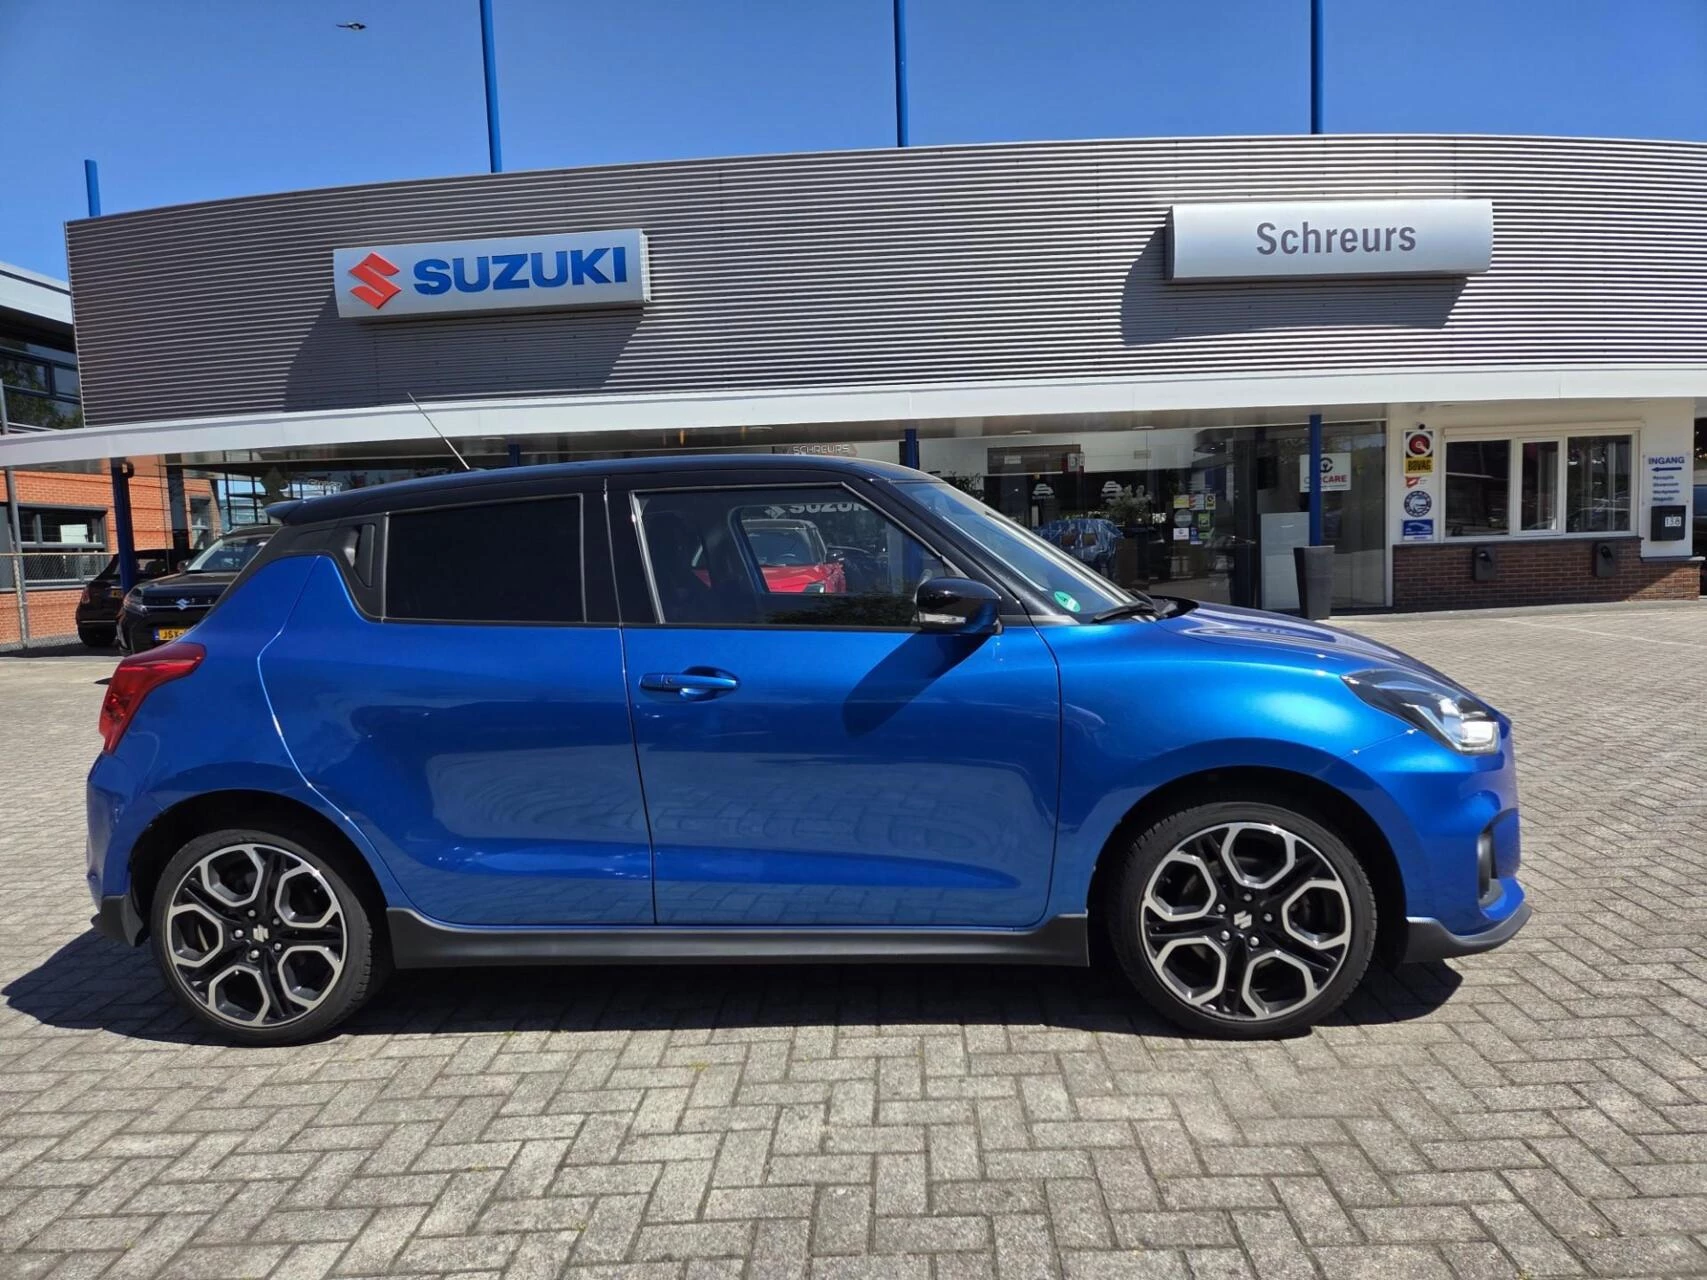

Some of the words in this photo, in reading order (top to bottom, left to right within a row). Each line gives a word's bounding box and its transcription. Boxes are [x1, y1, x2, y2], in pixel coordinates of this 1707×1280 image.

[1256, 221, 1416, 255] Schreurs
[413, 246, 628, 295] SUZUKI
[1648, 456, 1685, 465] INGANG
